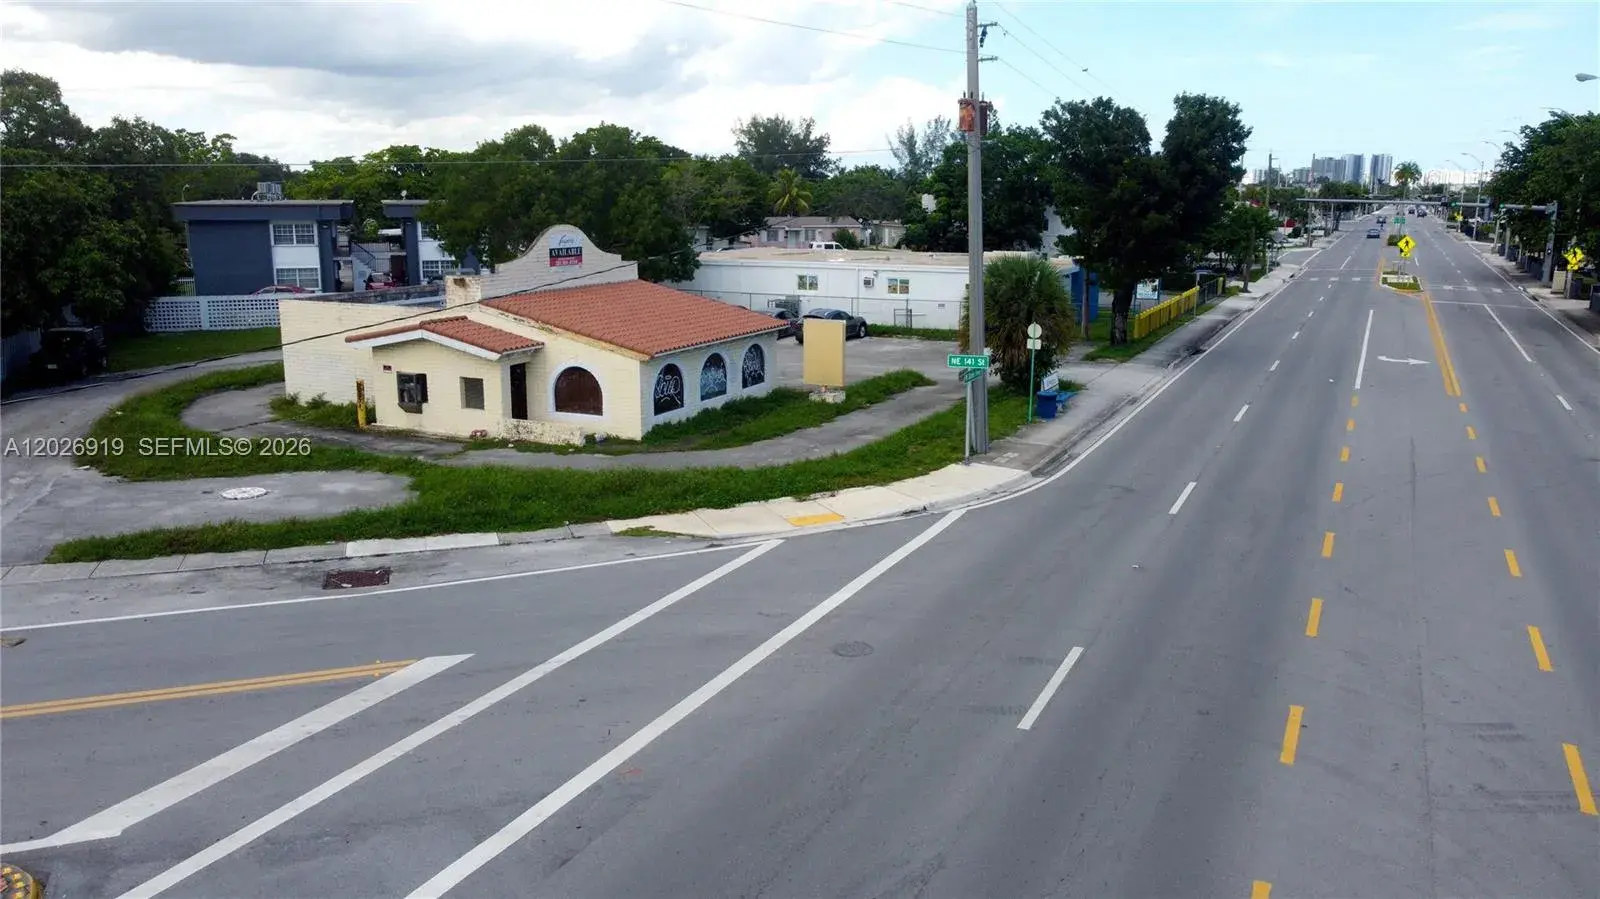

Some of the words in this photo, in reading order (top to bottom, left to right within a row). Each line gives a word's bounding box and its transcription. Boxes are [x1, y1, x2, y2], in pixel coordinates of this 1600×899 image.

[551, 247, 581, 256] AVAILABLE
[951, 357, 961, 365] NE
[977, 358, 985, 366] St
